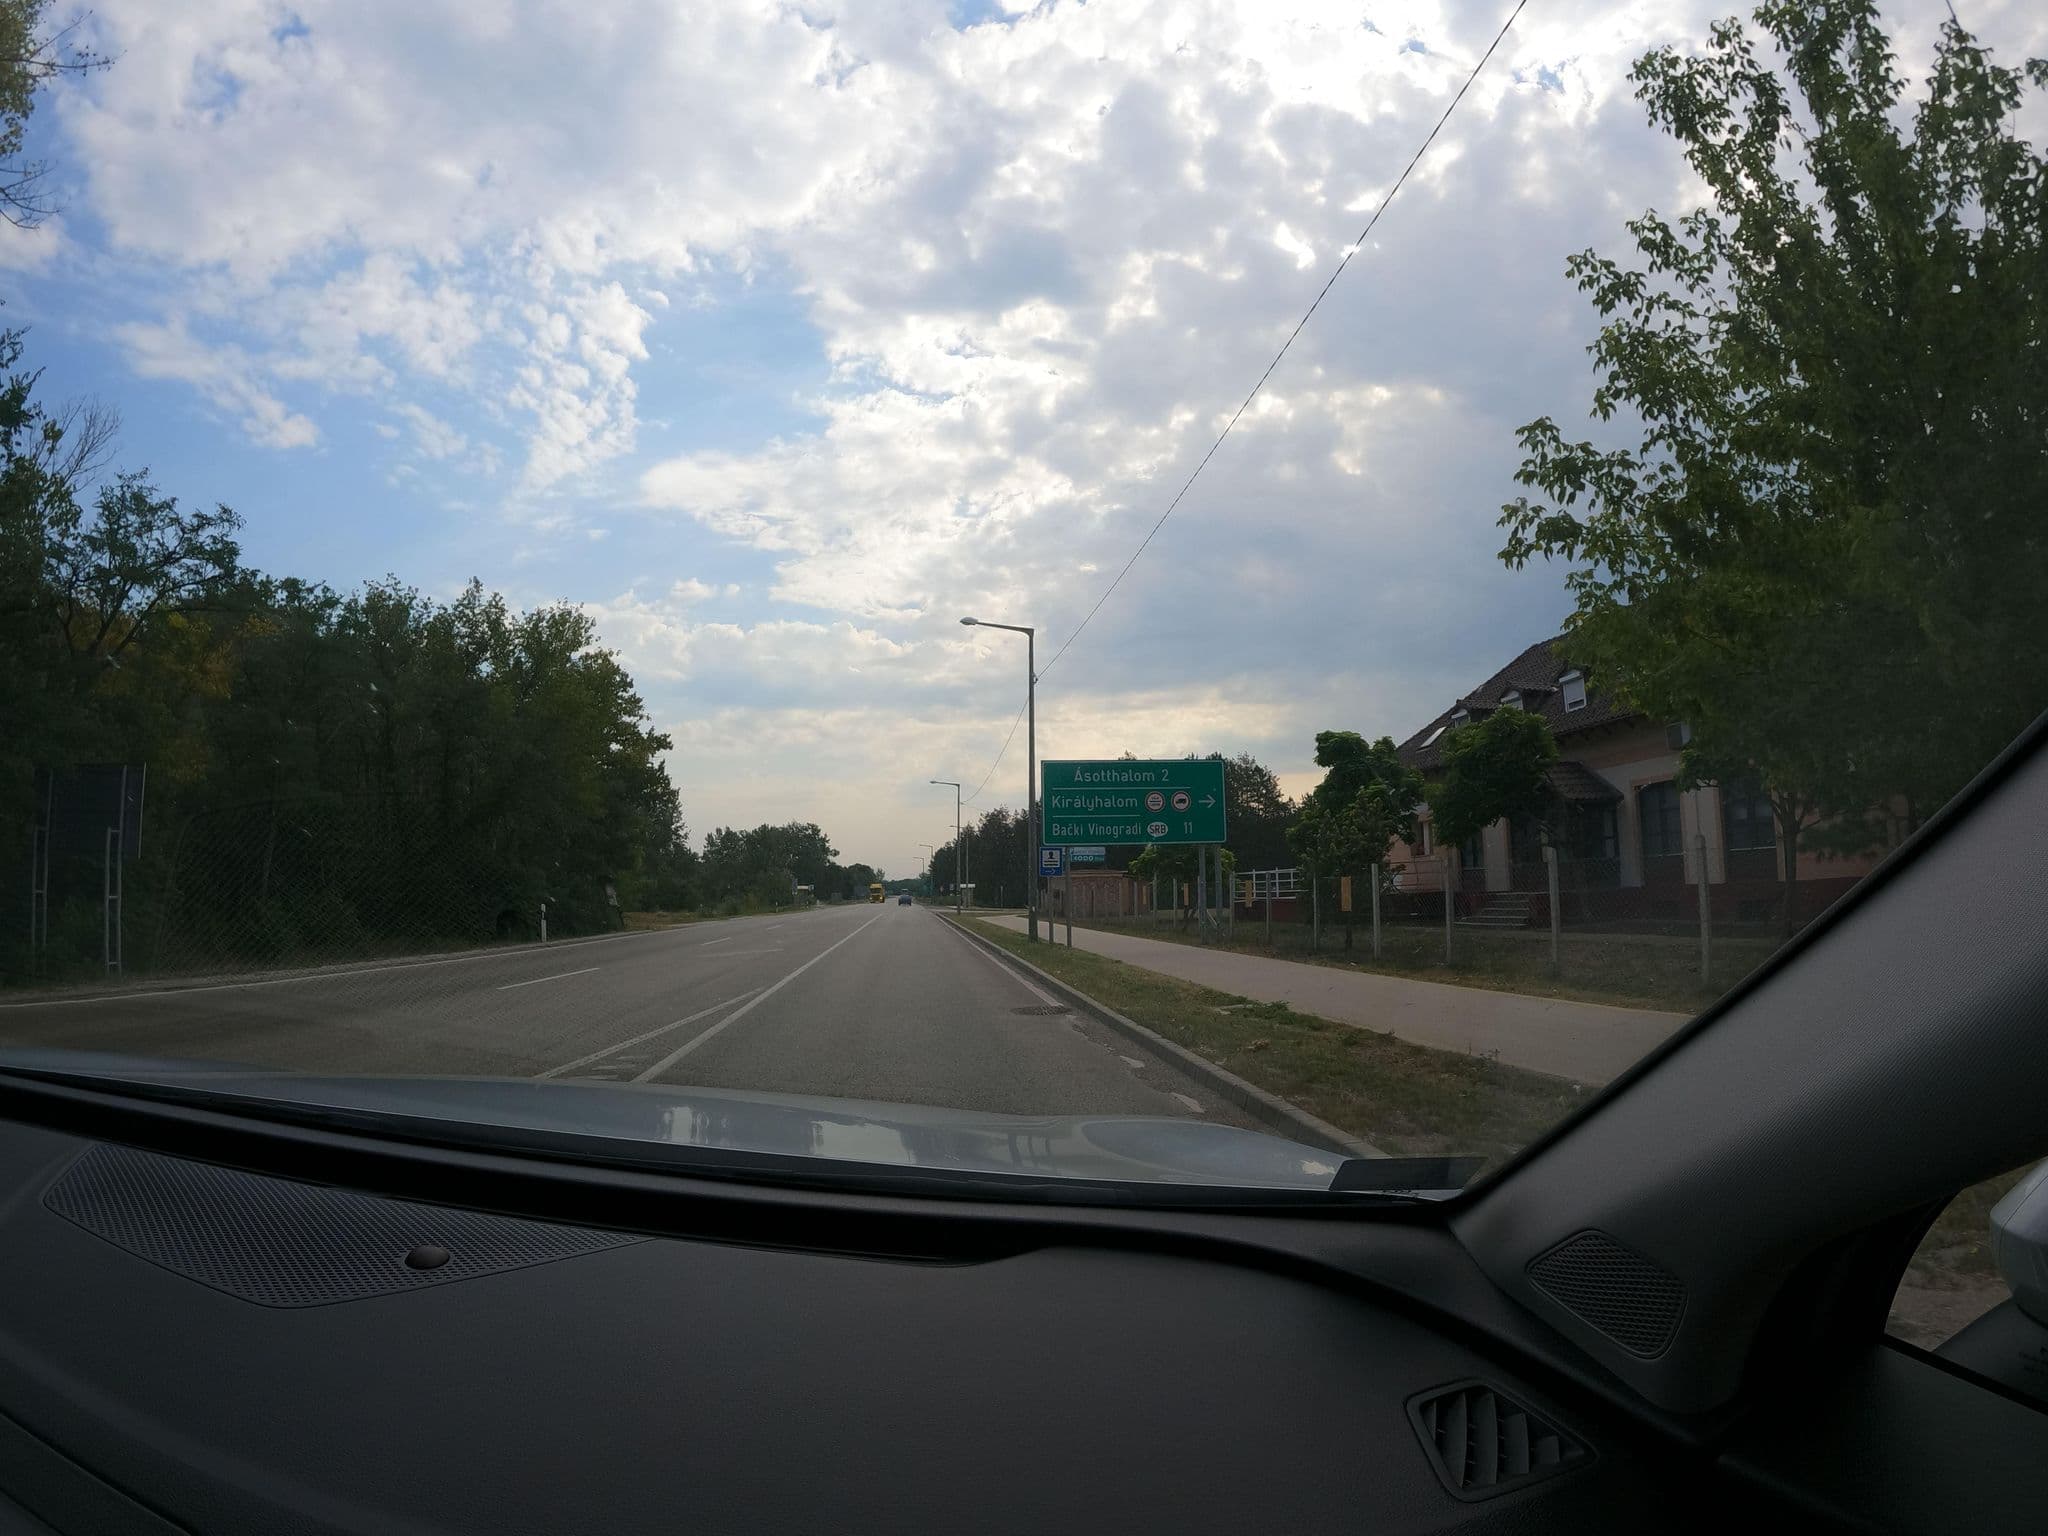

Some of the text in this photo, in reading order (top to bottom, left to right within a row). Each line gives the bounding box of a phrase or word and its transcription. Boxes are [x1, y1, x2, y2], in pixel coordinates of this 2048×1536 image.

[1074, 766, 1169, 782] Ásotthalom 2
[1052, 795, 1138, 811] Királyhalom
[1052, 821, 1193, 838] Bački Vinogradi SRB 11
